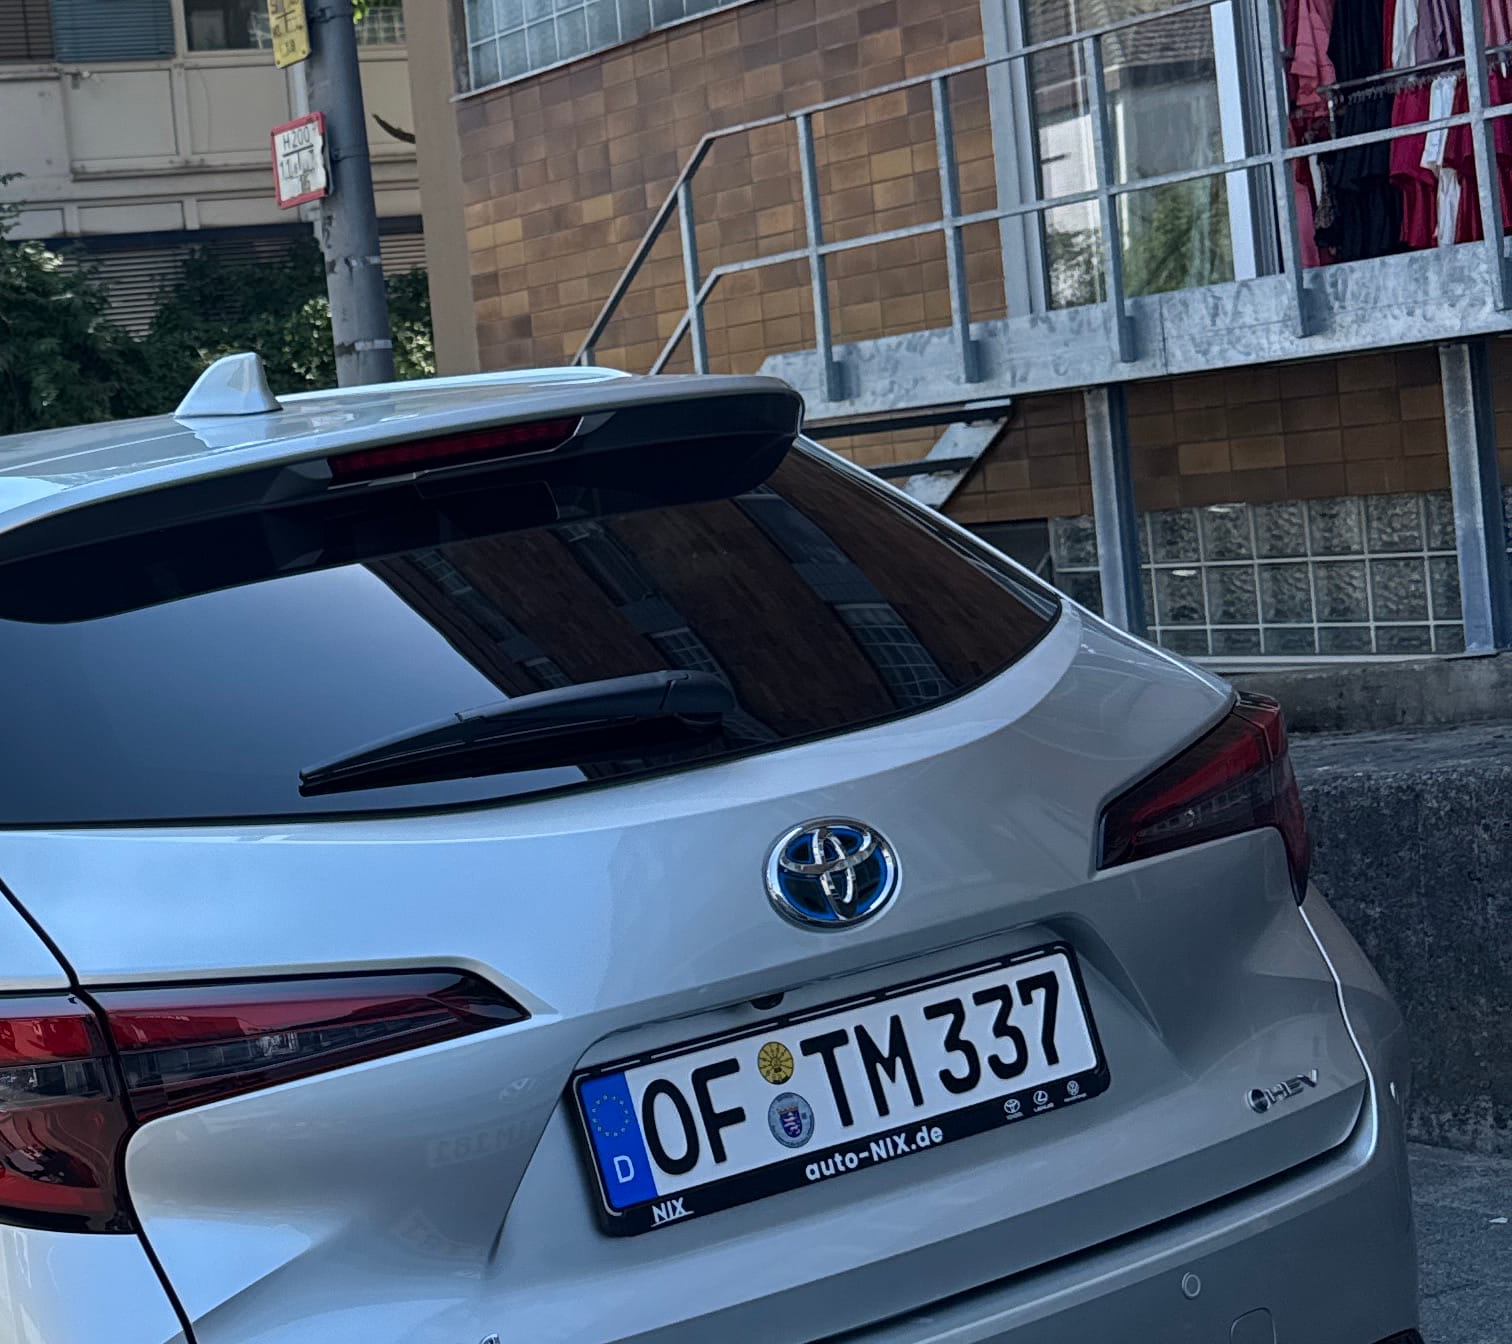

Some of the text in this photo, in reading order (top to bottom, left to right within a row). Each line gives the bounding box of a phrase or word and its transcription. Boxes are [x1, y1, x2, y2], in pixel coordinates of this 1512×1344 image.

[283, 126, 311, 150] H200
[642, 1058, 746, 1176] OF
[800, 1014, 924, 1127] TM
[923, 970, 1059, 1095] 337
[613, 1154, 635, 1183] D
[805, 1125, 944, 1182] auto-NIX.de
[652, 1196, 694, 1227] NIX
